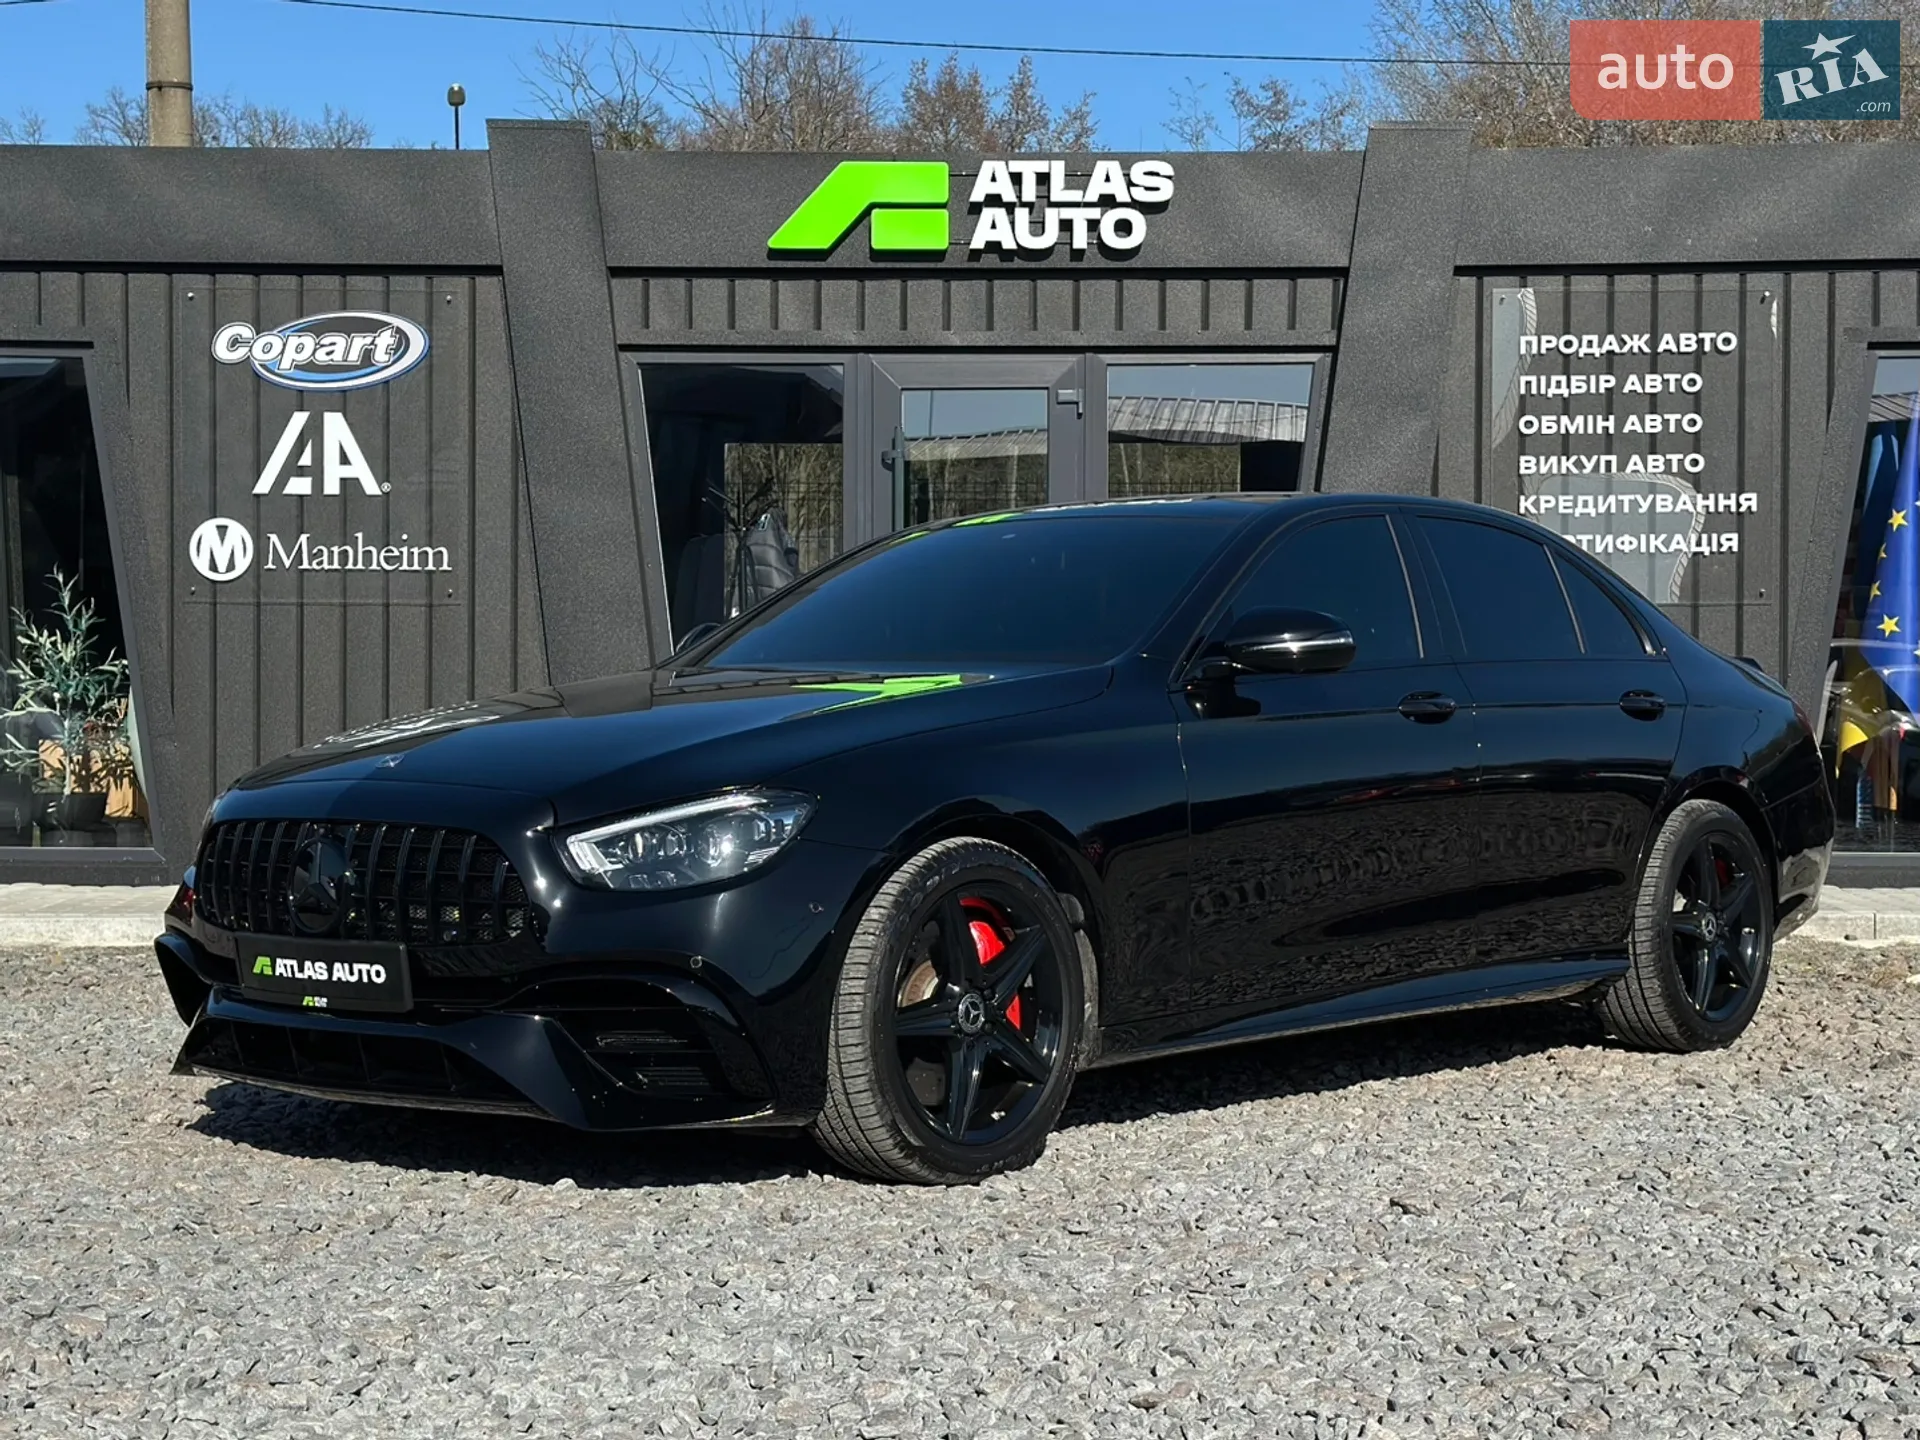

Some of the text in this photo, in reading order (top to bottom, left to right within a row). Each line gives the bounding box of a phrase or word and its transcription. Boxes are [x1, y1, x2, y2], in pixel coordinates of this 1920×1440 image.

[968, 160, 1175, 203] ATLAS
[968, 207, 1148, 250] AUTO
[211, 321, 399, 373] Copart
[1519, 332, 1738, 358] ПРОДАЖ АВТО
[1519, 373, 1704, 398] ПІДБІР АВТО
[1518, 413, 1704, 435] ОБМІН АВТО
[1519, 453, 1706, 475] ВИКУП АВТО
[1519, 493, 1758, 517] КРЕДИТУВАННЯ
[264, 532, 452, 571] Manheim
[275, 958, 387, 984] ATLAS AUTO
